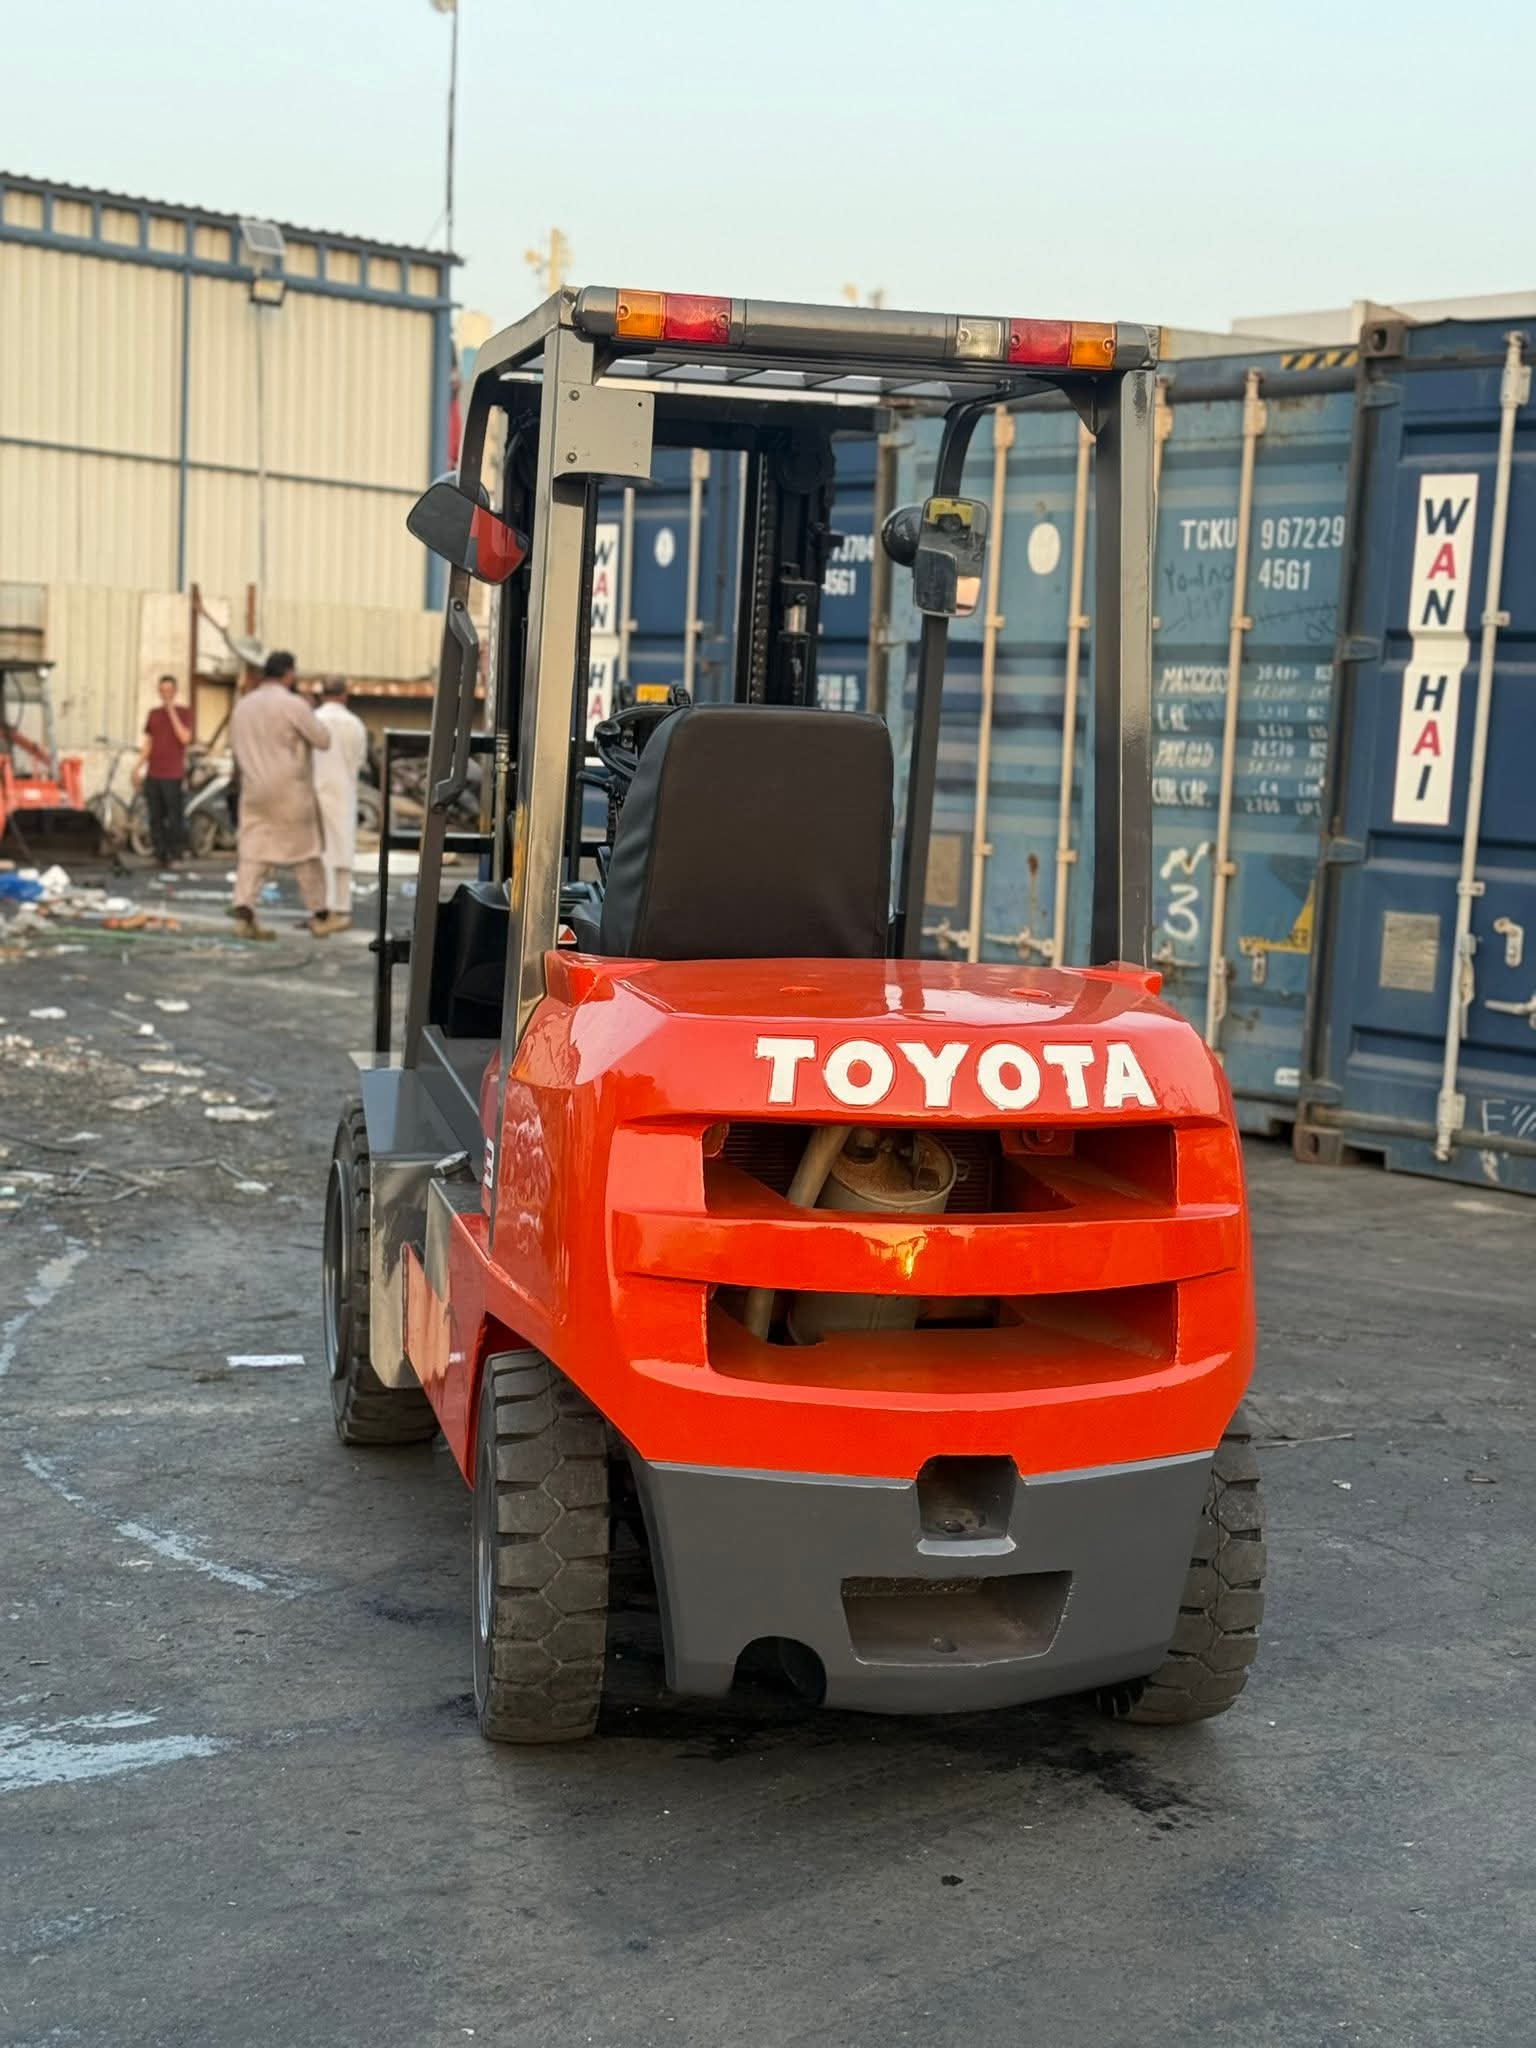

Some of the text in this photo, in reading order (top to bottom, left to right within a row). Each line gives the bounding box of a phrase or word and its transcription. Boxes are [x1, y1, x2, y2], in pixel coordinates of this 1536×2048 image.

[1181, 516, 1346, 550] TCKU 967229
[1258, 559, 1311, 590] 45G1
[1411, 498, 1470, 801] WAN HAI
[587, 663, 606, 720] HA
[755, 1037, 1159, 1110] TOYOTA
